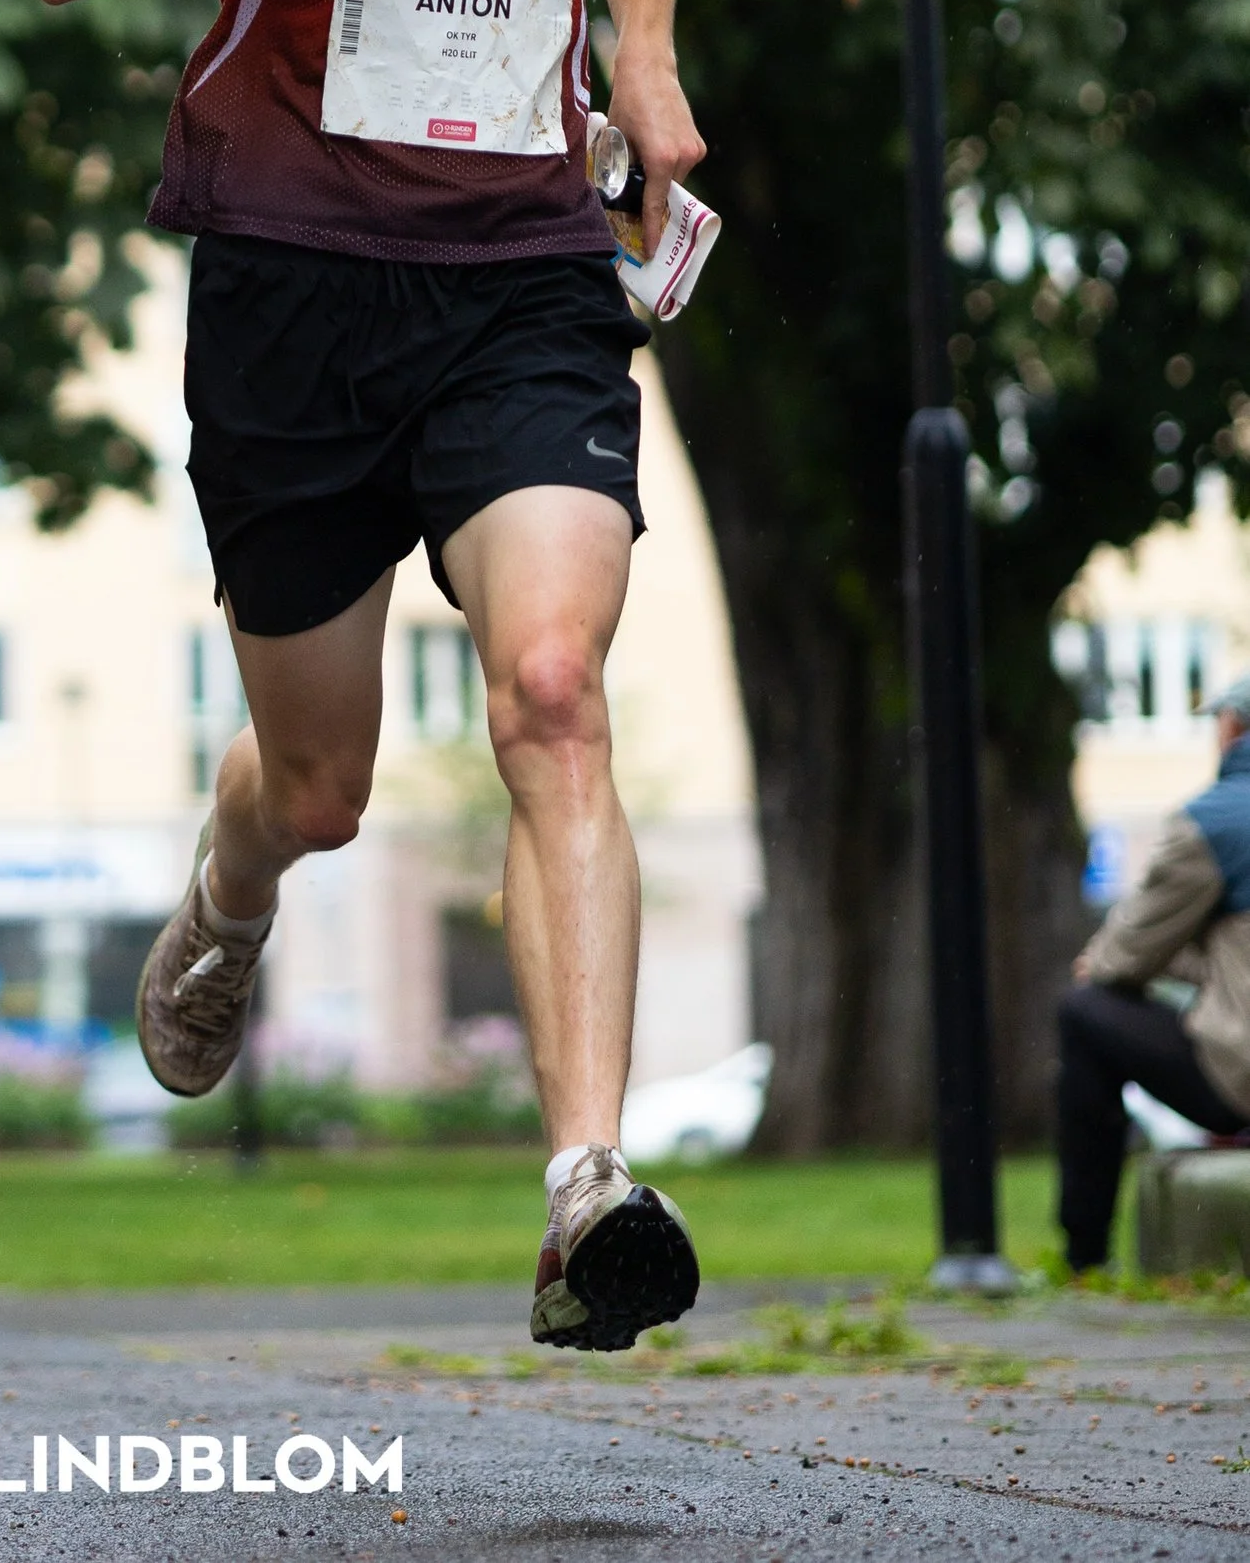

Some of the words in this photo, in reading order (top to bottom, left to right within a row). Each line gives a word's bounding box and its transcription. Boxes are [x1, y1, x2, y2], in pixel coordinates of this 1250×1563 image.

[446, 30, 459, 40] OK
[461, 32, 477, 41] TYR
[460, 49, 477, 59] ELIT
[665, 199, 697, 267] sprinten
